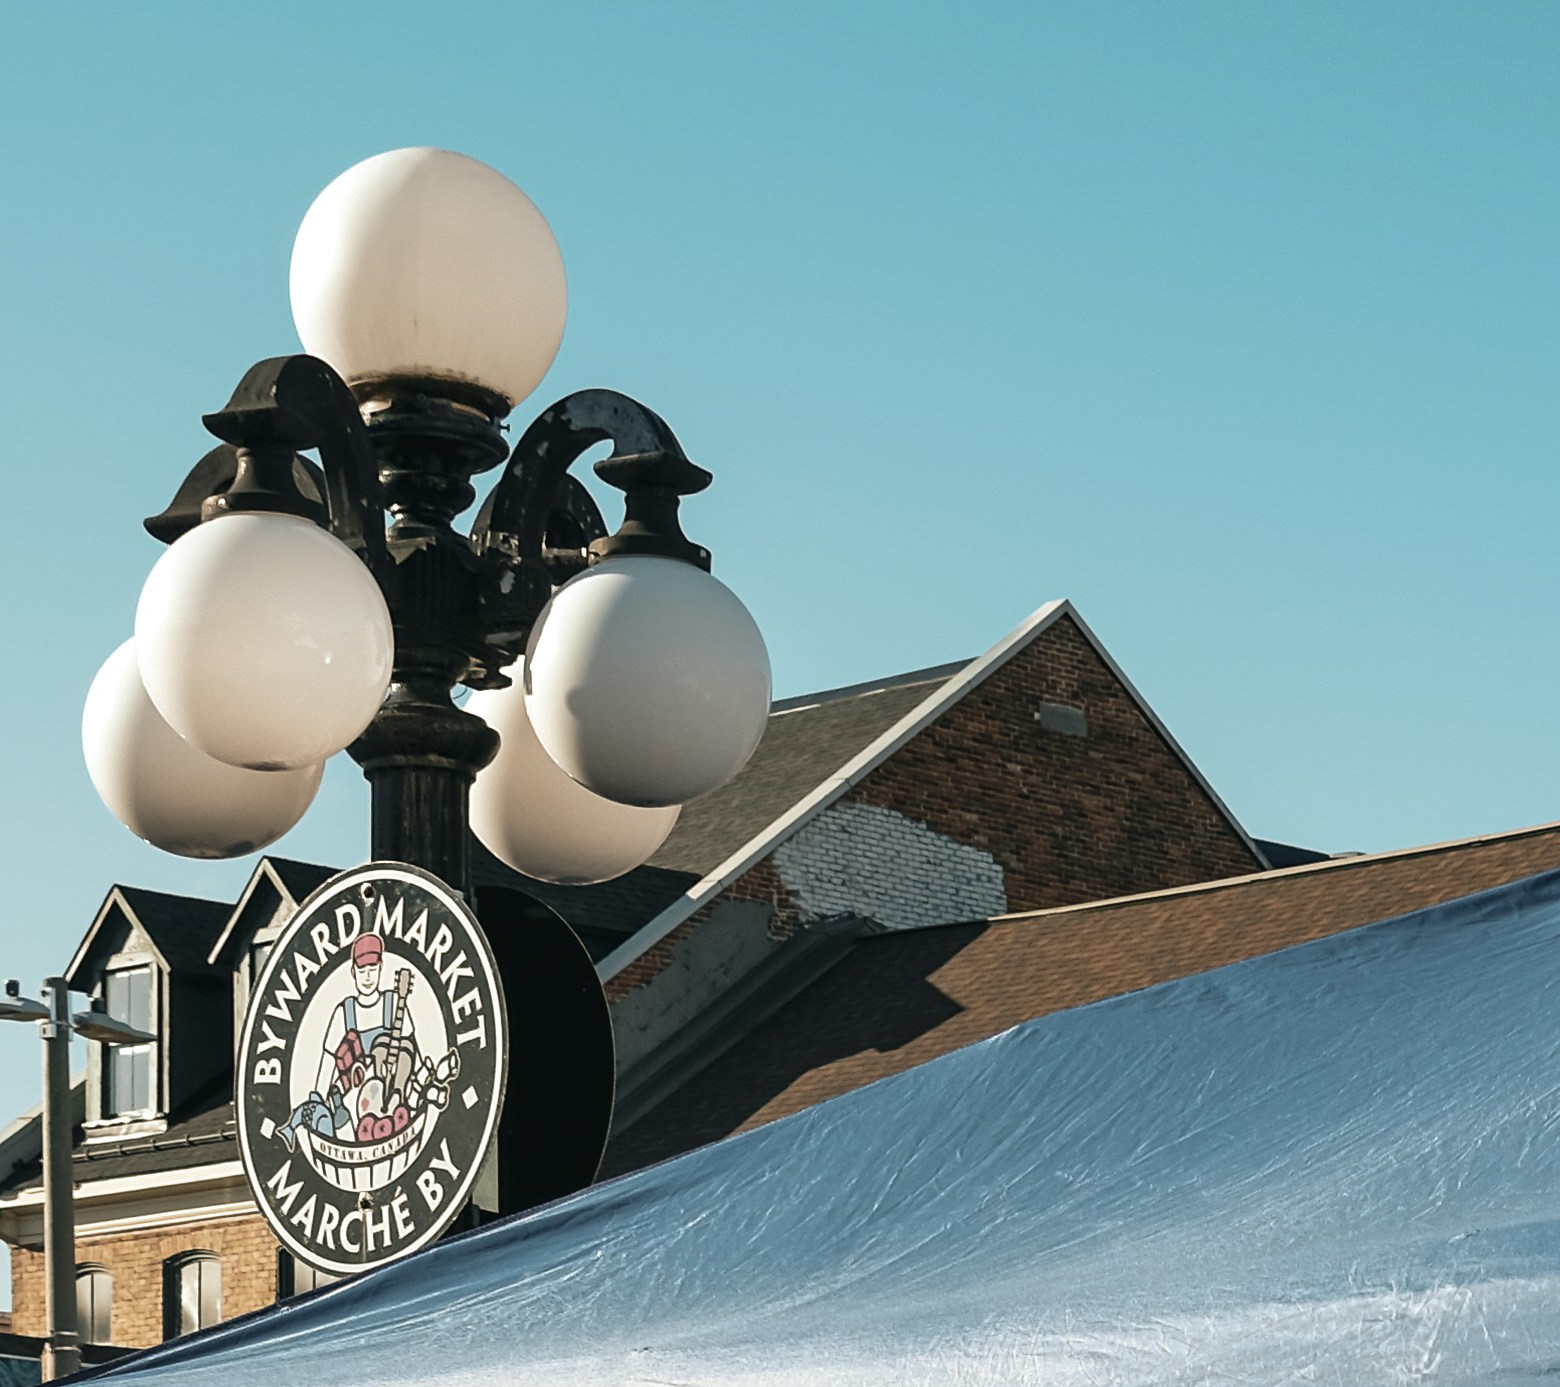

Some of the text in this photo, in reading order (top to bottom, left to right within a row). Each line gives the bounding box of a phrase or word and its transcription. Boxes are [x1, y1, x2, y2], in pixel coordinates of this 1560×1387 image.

[254, 895, 488, 1086] BYWARD MARKET
[267, 1138, 462, 1254] MARCHÉ BY
[372, 1125, 418, 1157] CANADA
